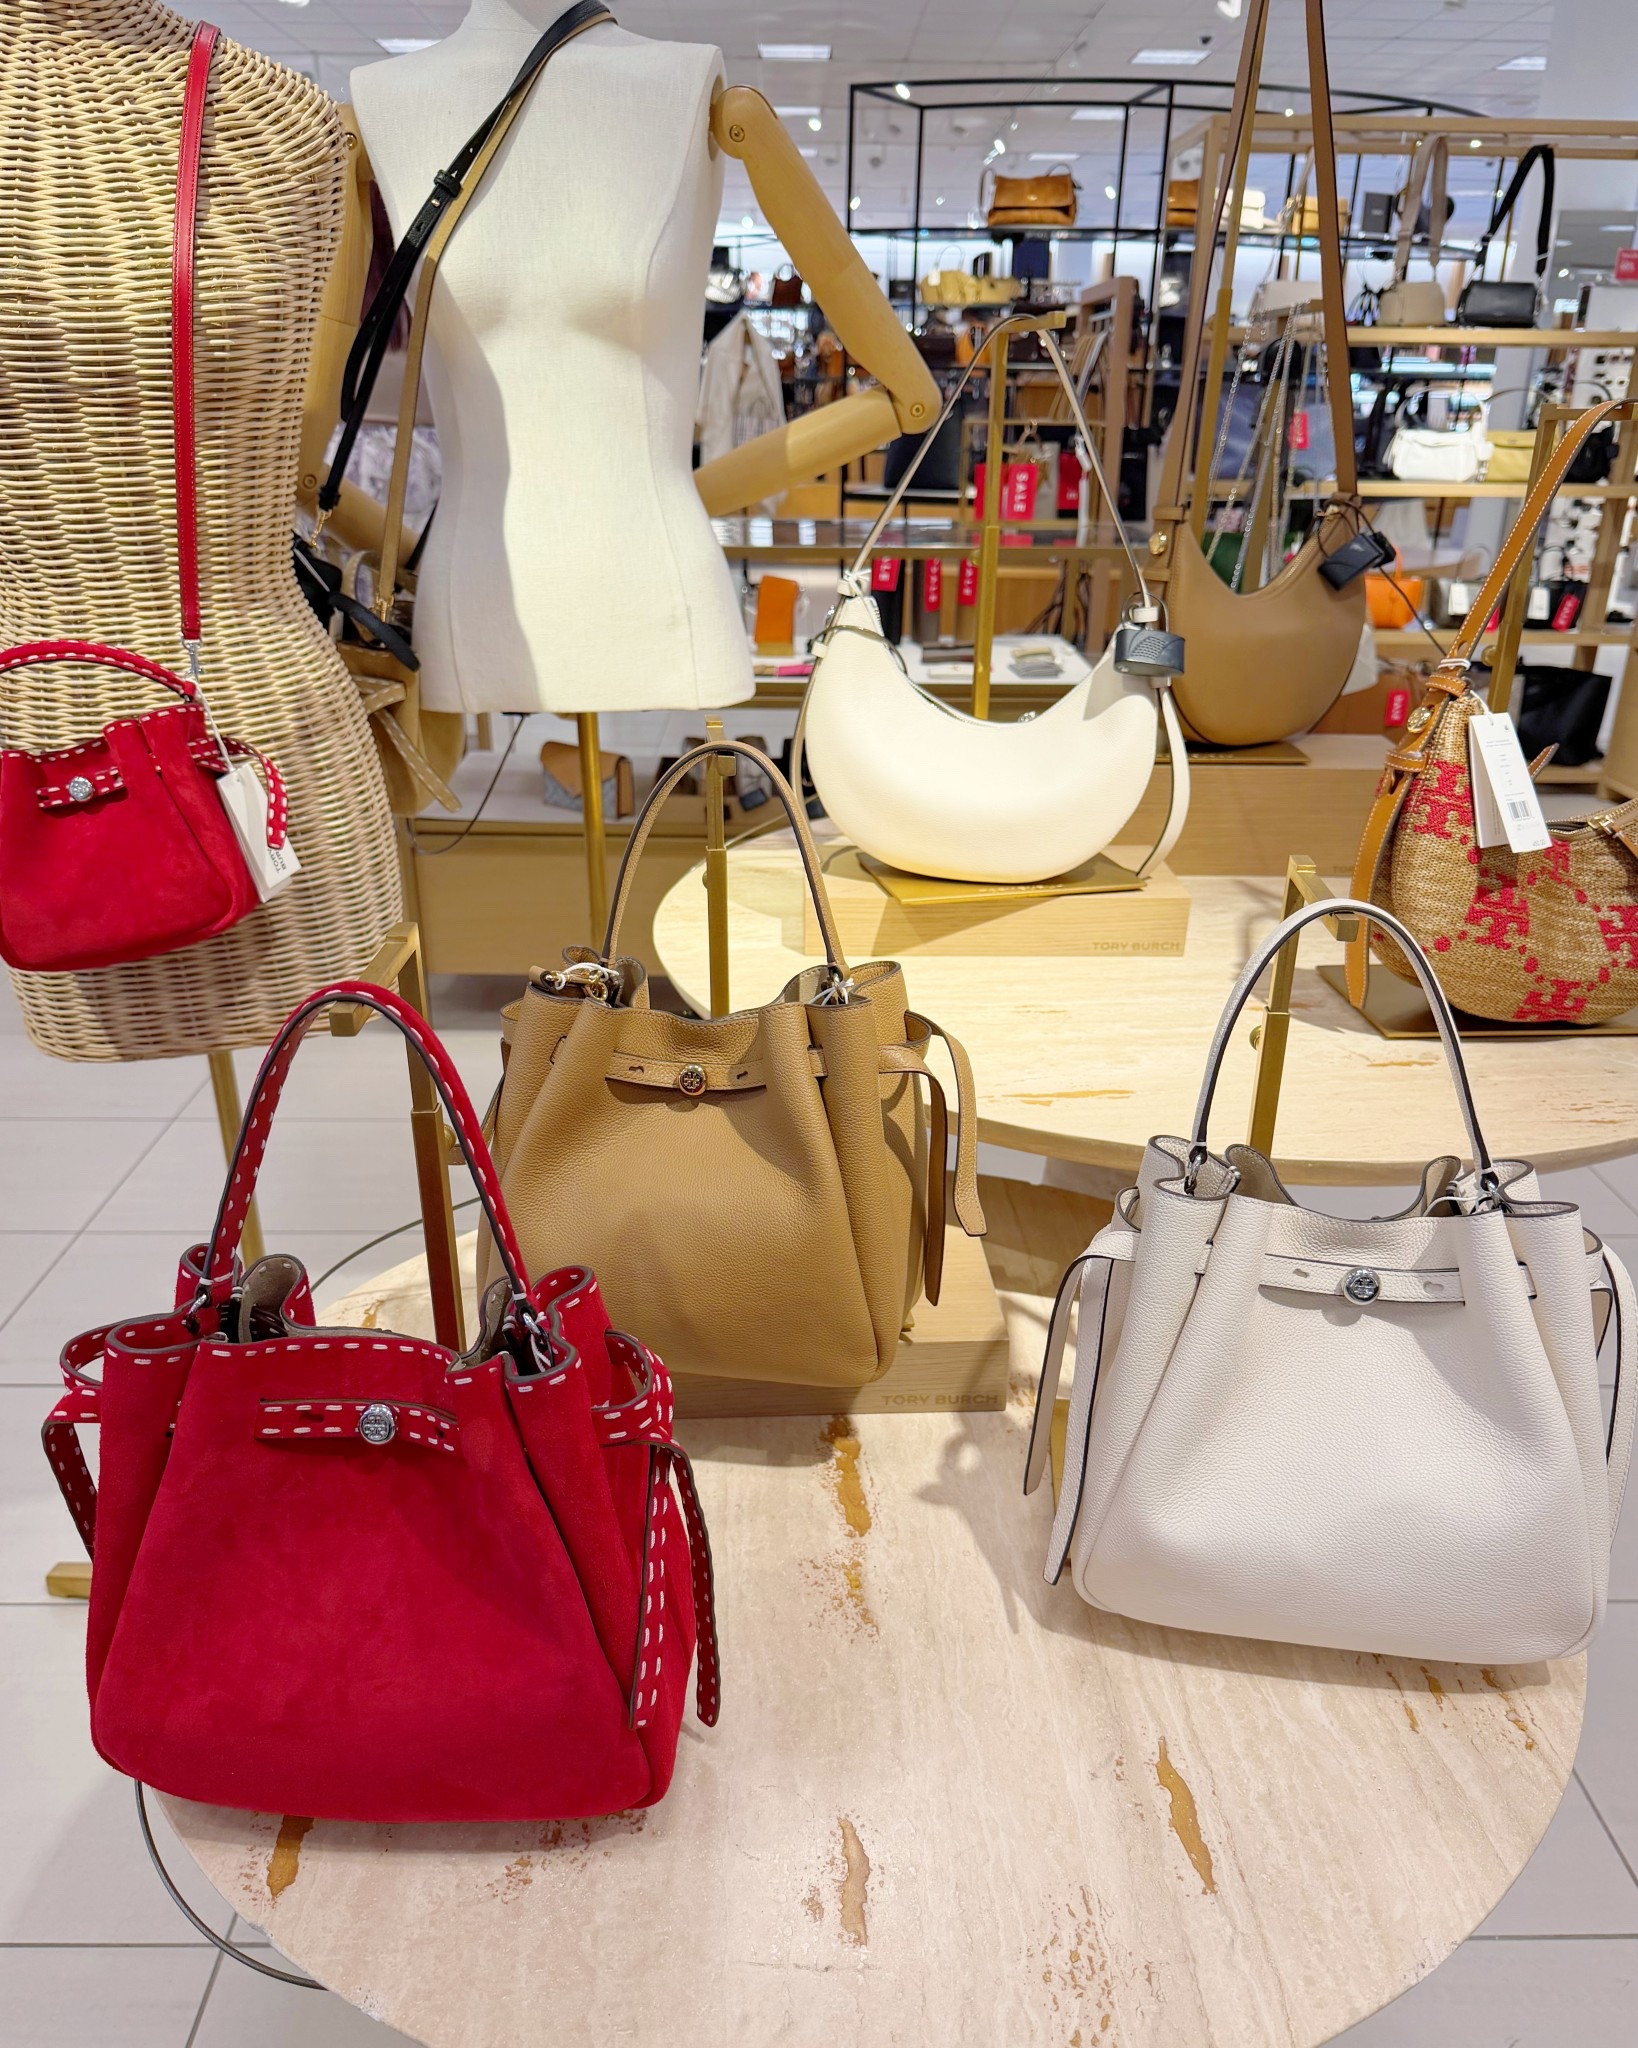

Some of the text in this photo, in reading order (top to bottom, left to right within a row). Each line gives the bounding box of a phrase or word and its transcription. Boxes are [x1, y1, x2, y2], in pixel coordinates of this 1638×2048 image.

[1013, 471, 1029, 513] SALE
[275, 850, 287, 871] BUR
[1092, 941, 1180, 951] TORY BURCH
[881, 1394, 999, 1406] TORY BURCH
